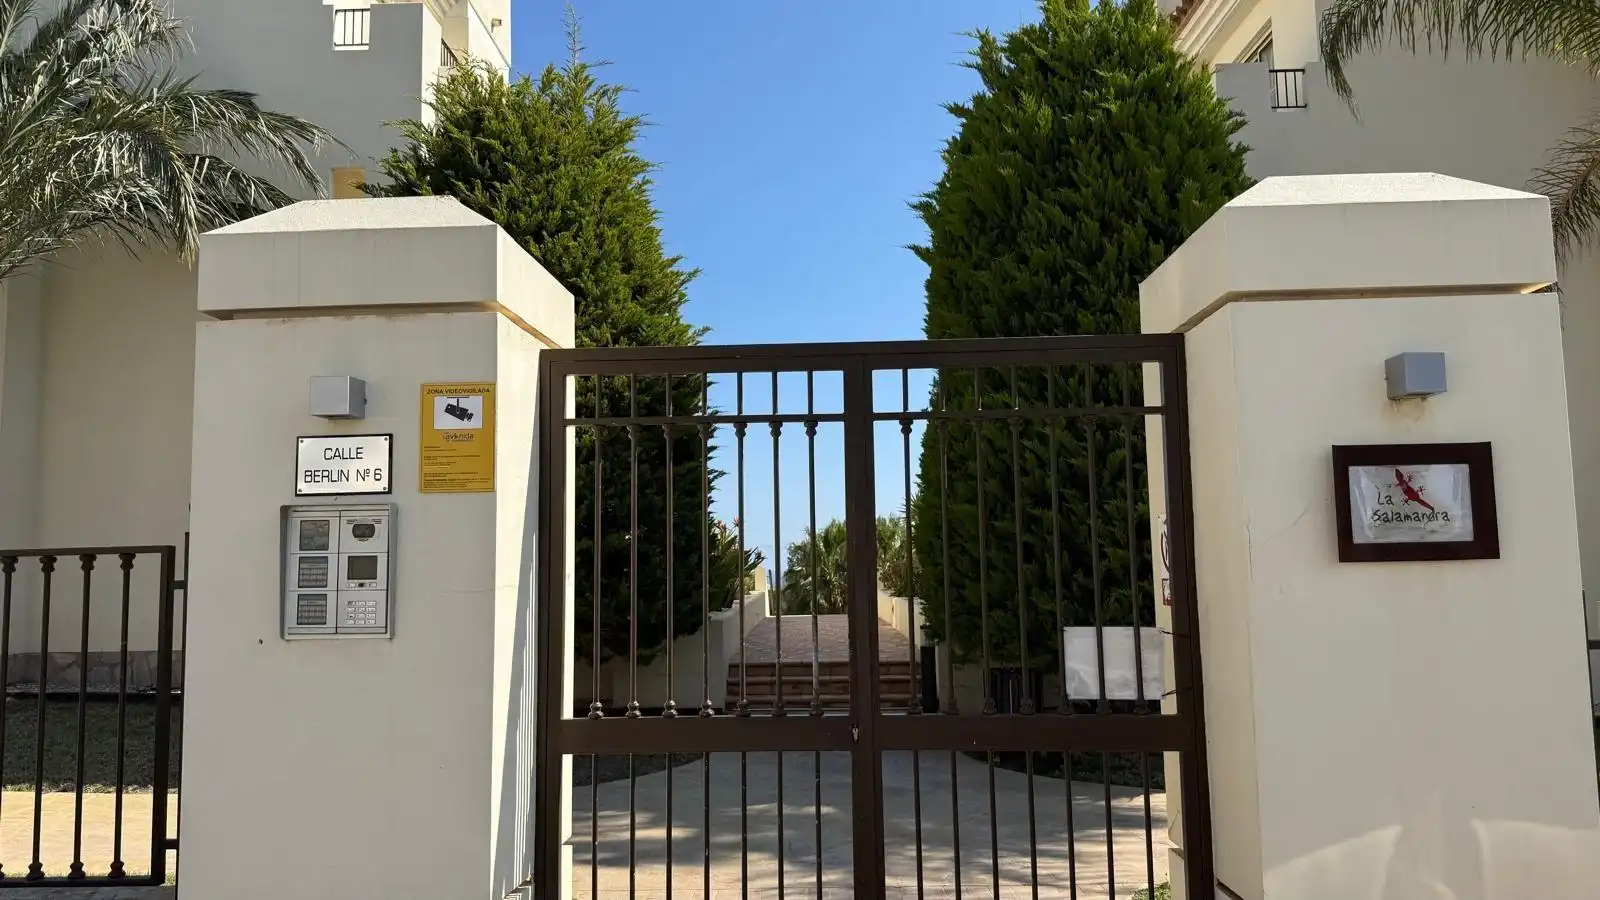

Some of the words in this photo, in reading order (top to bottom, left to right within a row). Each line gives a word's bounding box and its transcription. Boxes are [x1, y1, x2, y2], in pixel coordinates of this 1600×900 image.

[323, 447, 364, 461] CALLE
[304, 468, 350, 483] BERLIN
[373, 468, 383, 482] 6
[1377, 491, 1394, 506] La
[1373, 509, 1450, 523] Salamandra
